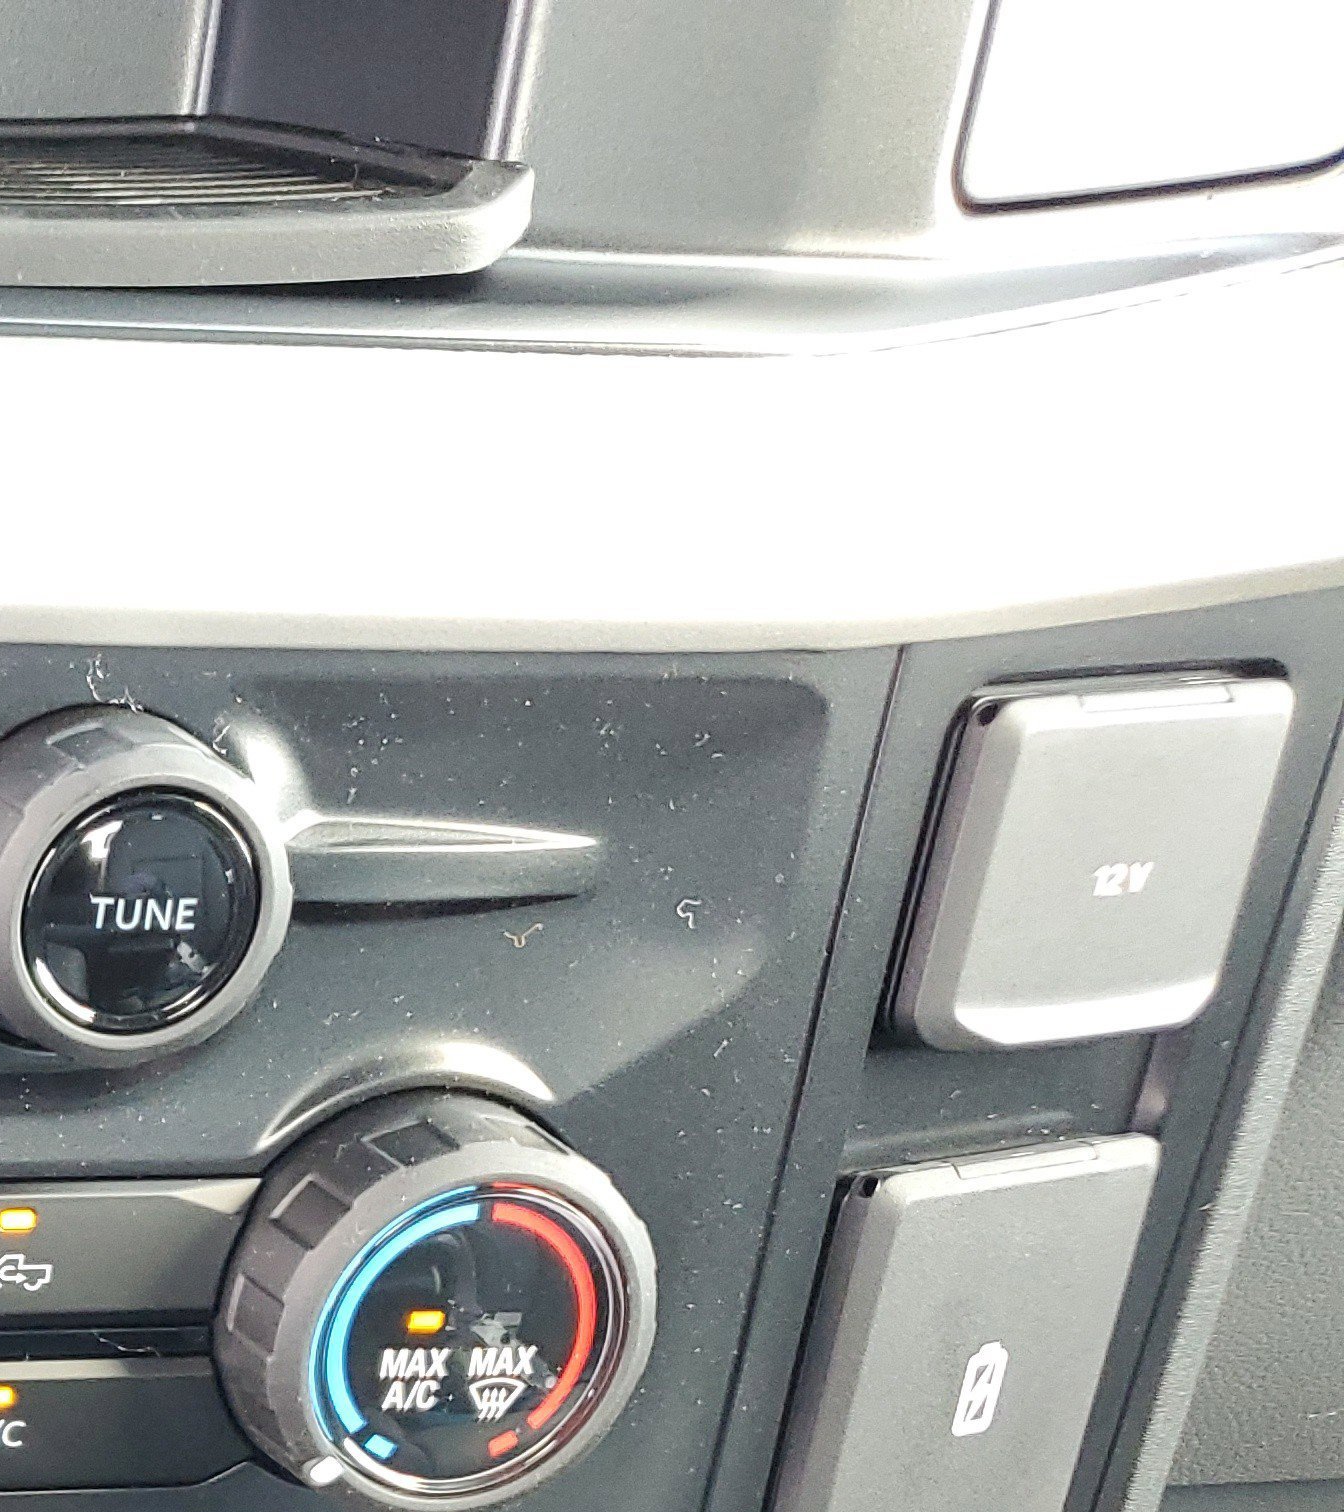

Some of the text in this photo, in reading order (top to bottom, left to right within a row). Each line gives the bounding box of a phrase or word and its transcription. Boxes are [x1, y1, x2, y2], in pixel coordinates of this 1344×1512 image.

[88, 892, 198, 932] TUNE
[379, 1347, 452, 1380] MAX
[468, 1345, 539, 1377] MAX
[380, 1379, 441, 1412] A/C
